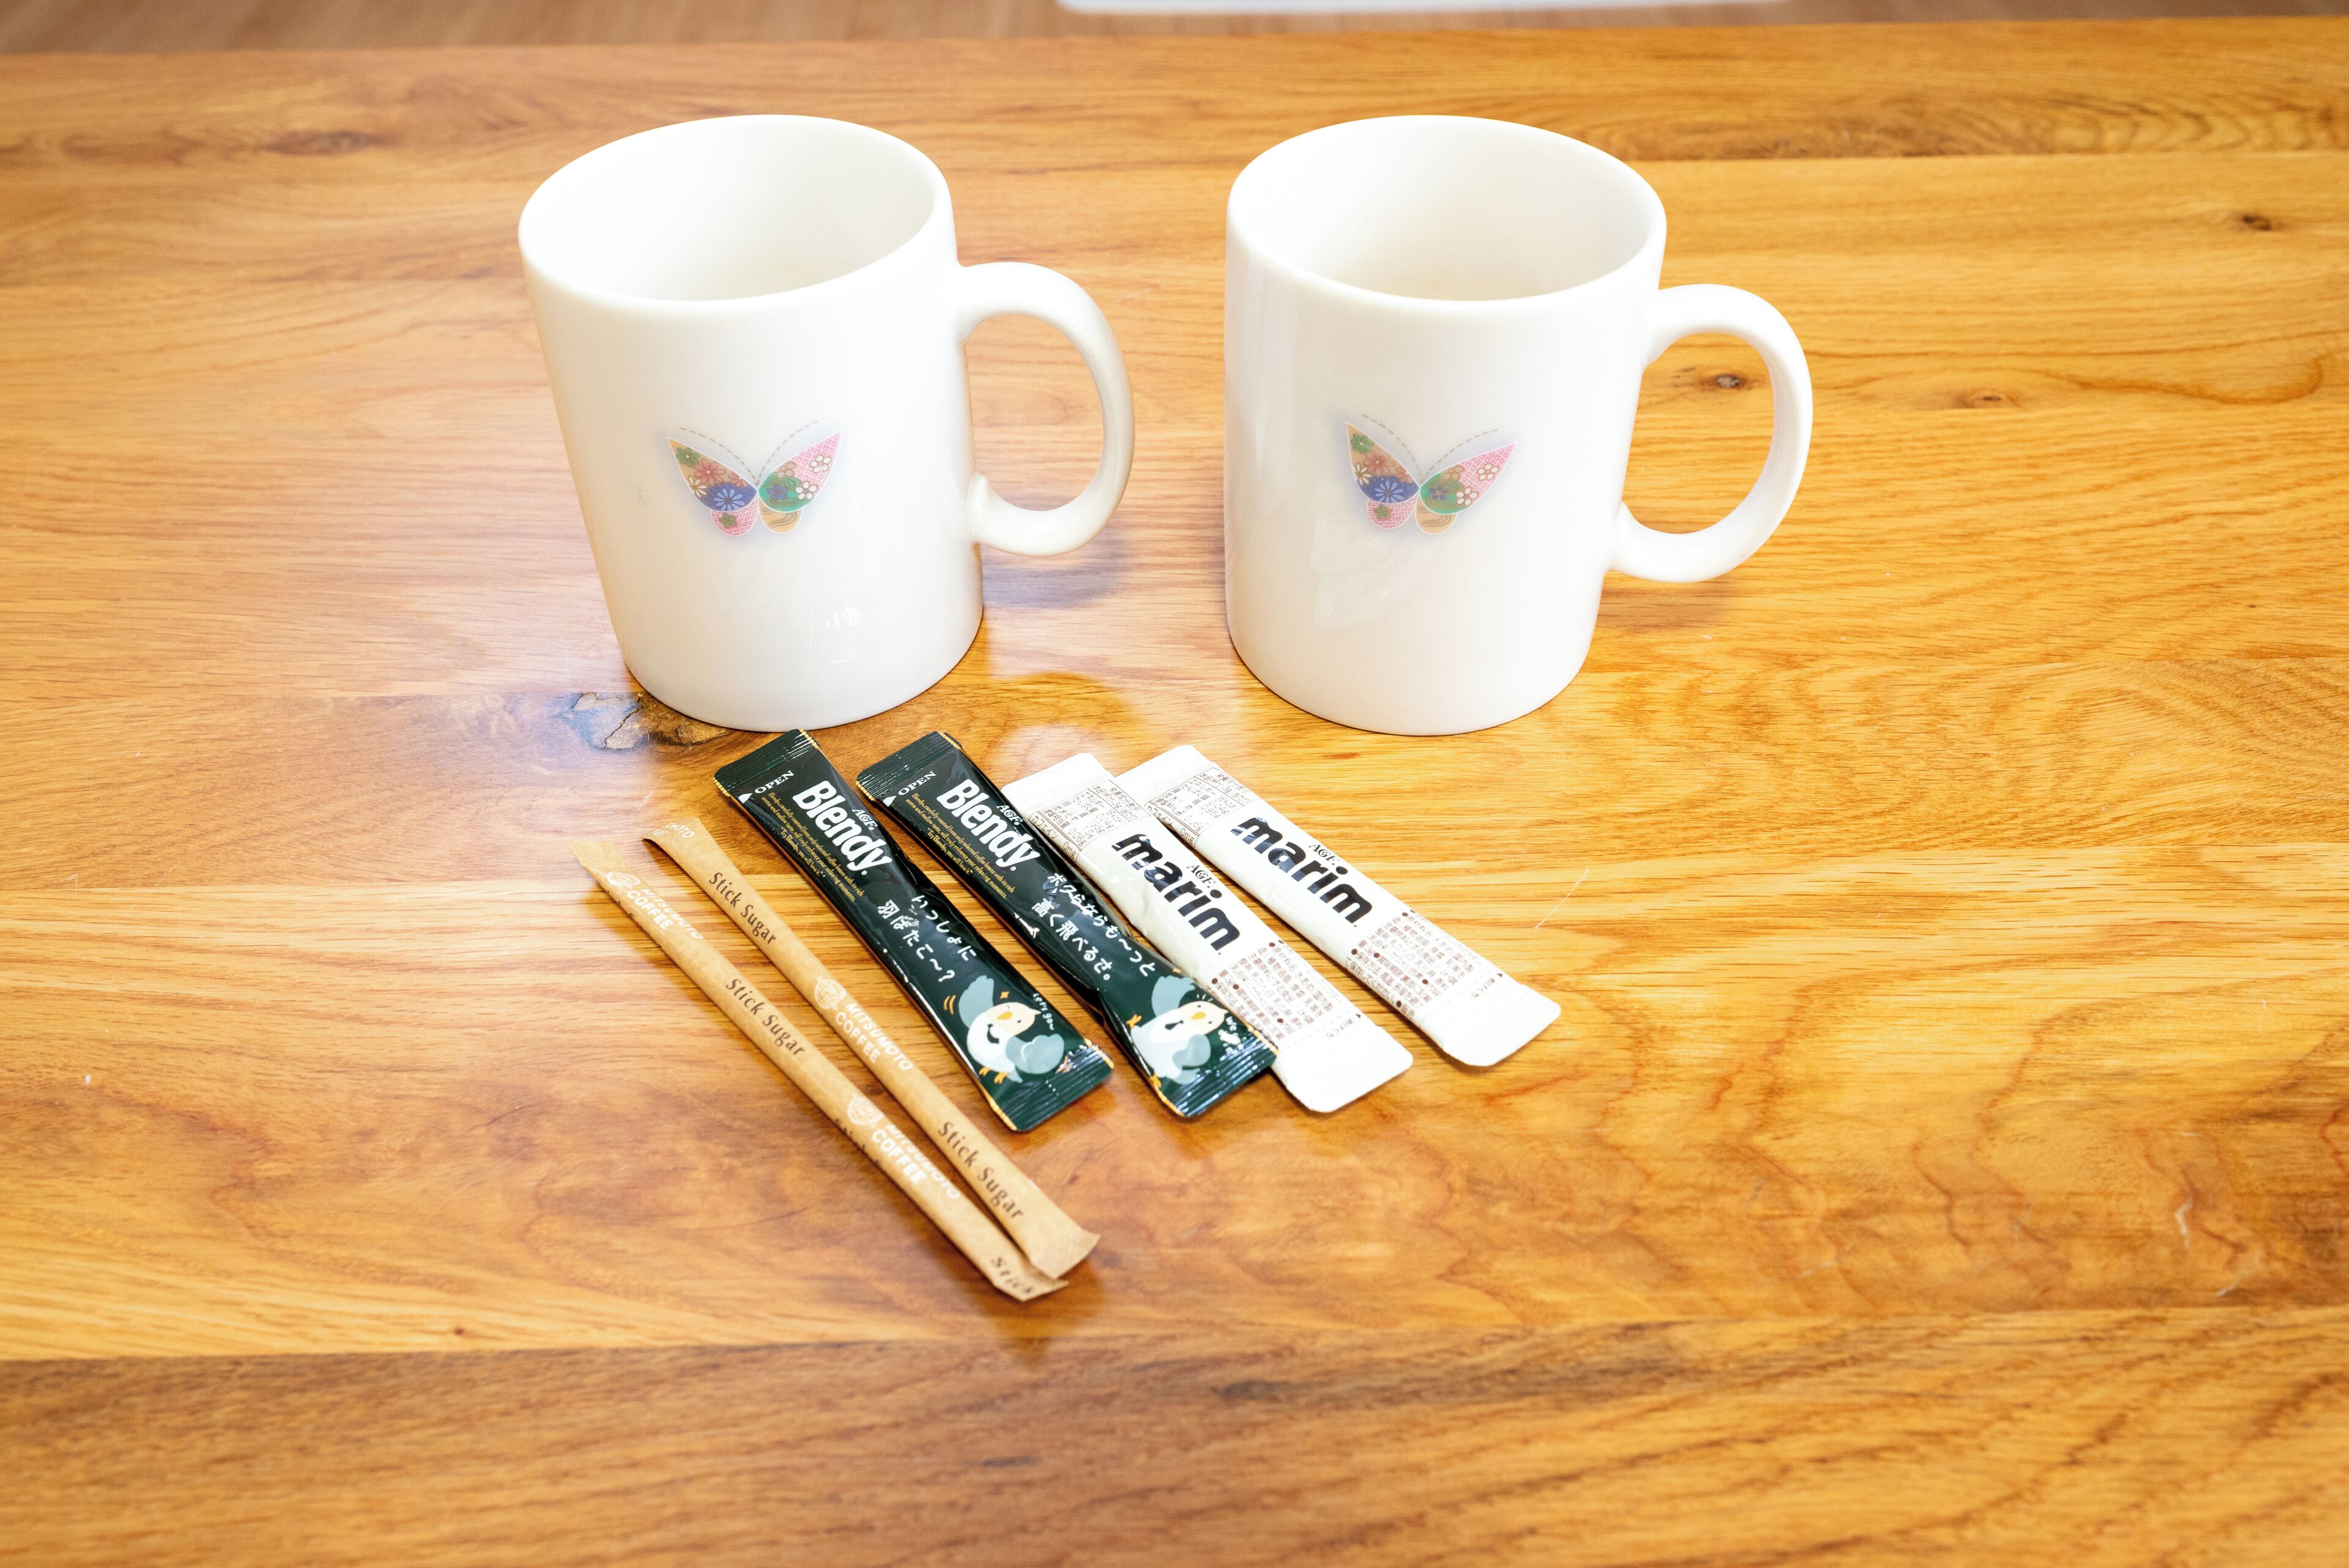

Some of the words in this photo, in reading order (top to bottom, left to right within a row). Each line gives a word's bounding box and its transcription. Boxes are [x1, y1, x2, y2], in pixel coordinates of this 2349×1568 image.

[754, 770, 794, 793] OPEN
[897, 770, 936, 795] OPEN
[1031, 815, 1058, 840] カフェイン
[626, 890, 674, 930] COFFEE
[708, 872, 742, 907] Stick
[740, 904, 776, 944] Sugar
[910, 894, 976, 961] いっしょに
[725, 978, 765, 1015] Stick
[762, 1014, 804, 1055] Sugar
[836, 1010, 881, 1062] COFFEE
[845, 1003, 913, 1069] MITSUMOTO
[872, 1129, 927, 1184] COFFEE
[937, 1121, 978, 1168] Stick
[976, 1167, 1023, 1218] Sugar
